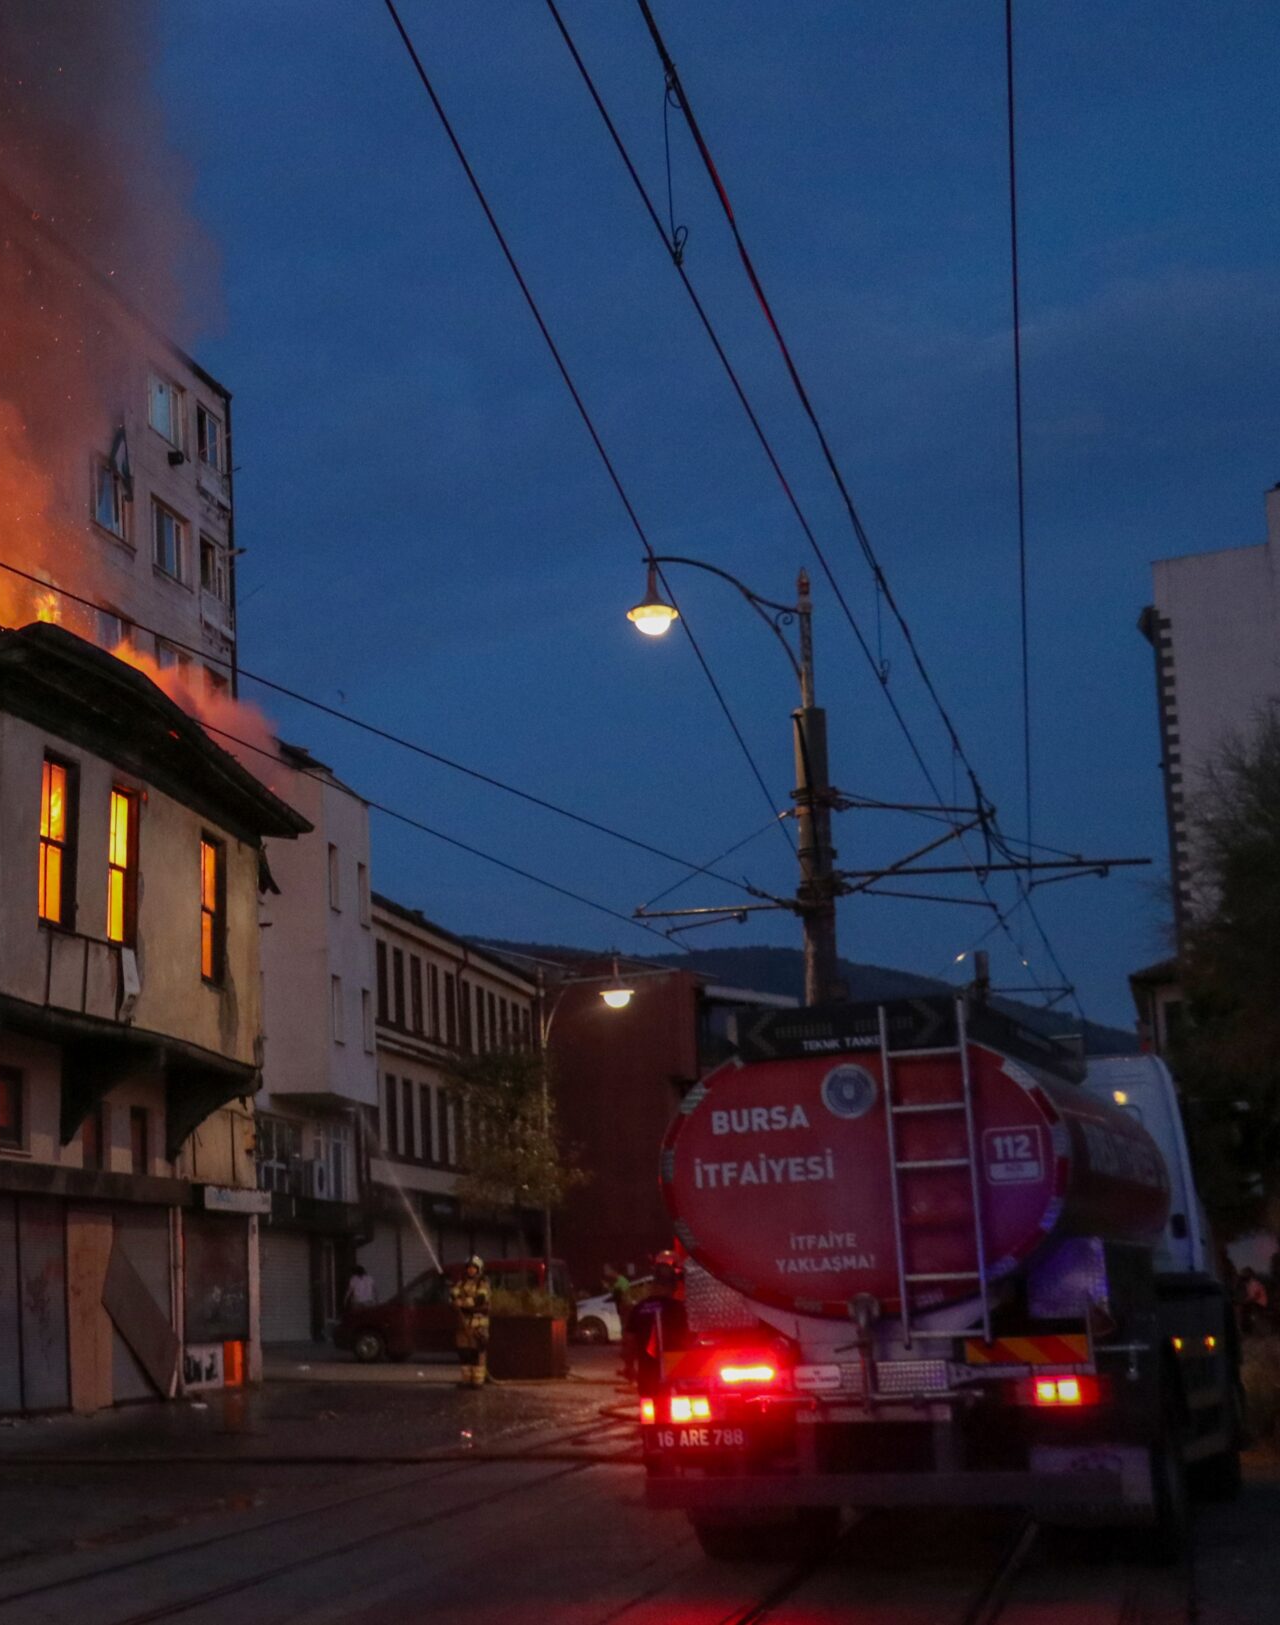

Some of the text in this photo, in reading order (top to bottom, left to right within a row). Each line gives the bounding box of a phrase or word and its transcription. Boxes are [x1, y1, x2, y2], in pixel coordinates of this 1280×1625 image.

[844, 1036, 882, 1047] TANKE
[712, 1105, 810, 1135] BURSA
[993, 1135, 1032, 1160] 112
[694, 1148, 834, 1188] İTFAİYESİ
[789, 1231, 857, 1250] İTFAİYE
[657, 1428, 743, 1447] 16 ARE 788
